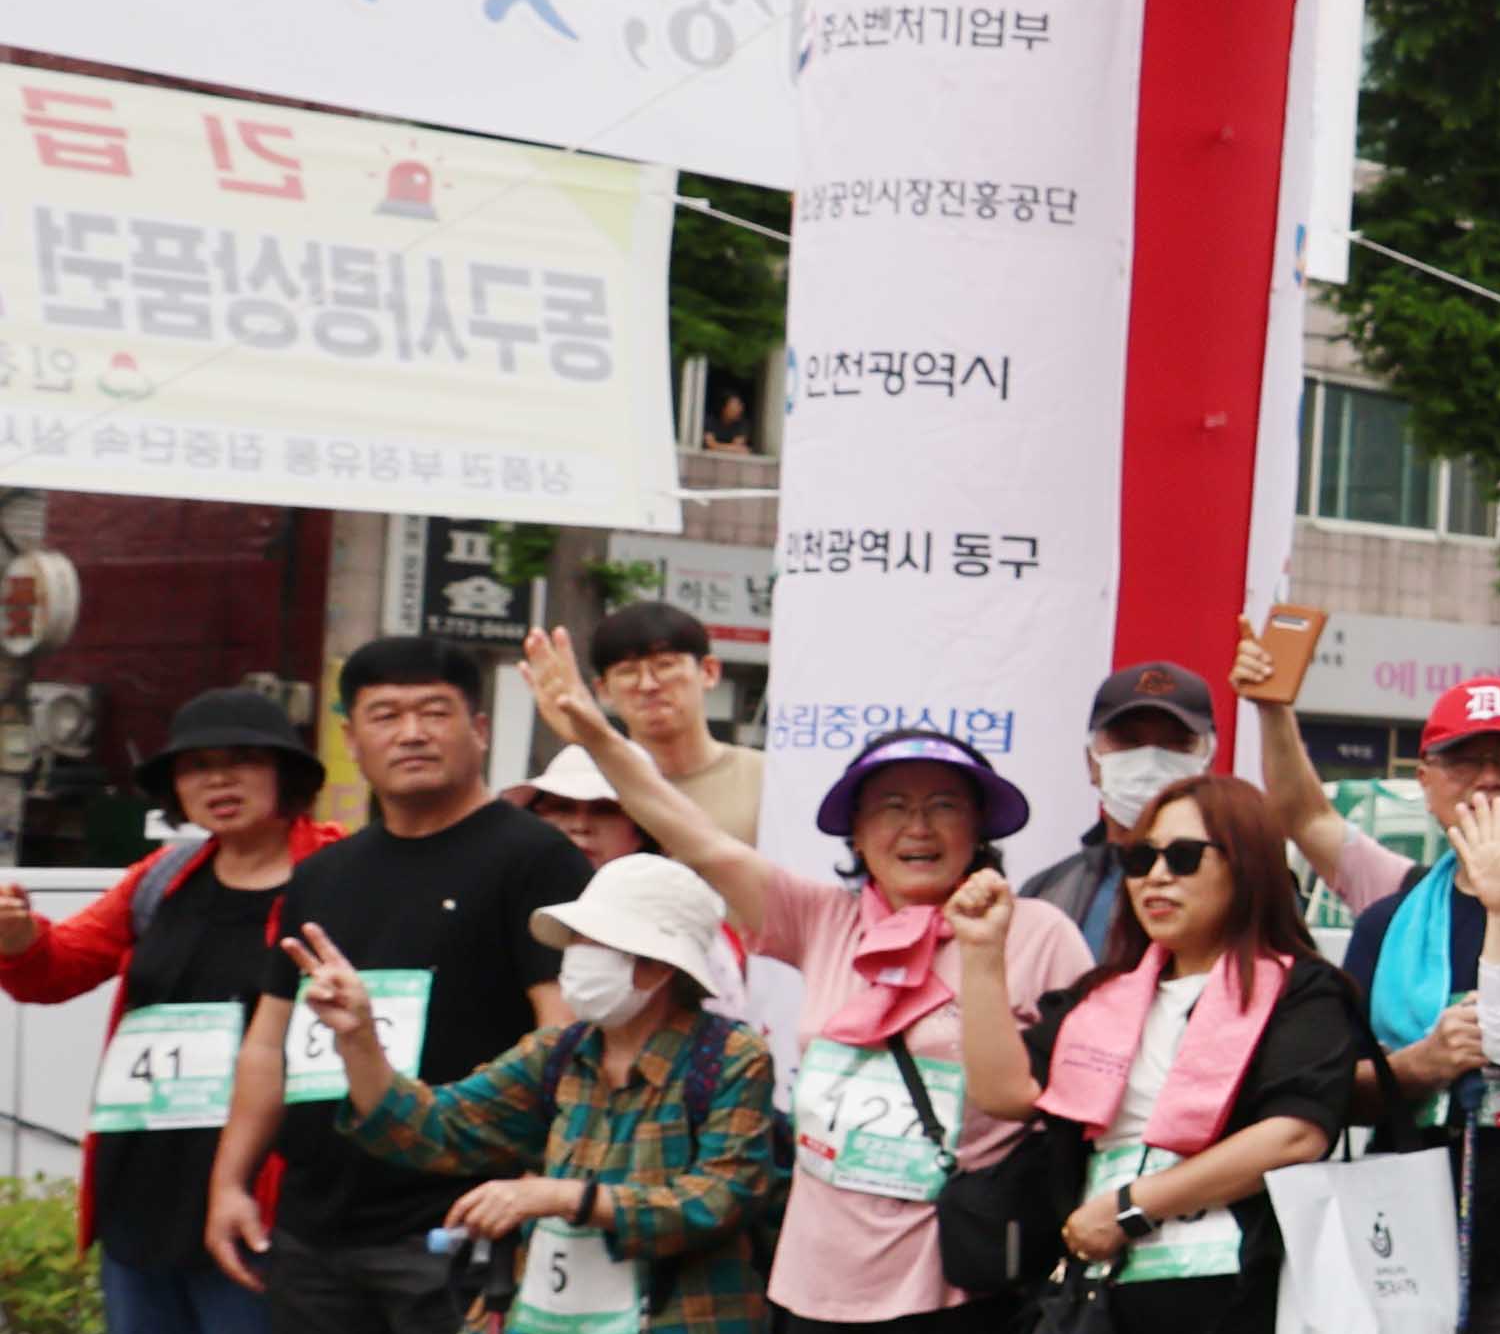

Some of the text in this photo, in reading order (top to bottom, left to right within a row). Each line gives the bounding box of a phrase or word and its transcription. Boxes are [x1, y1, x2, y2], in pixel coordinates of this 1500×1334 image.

[805, 349, 1012, 402] 인천광역시
[952, 532, 1040, 579] 동구
[128, 1044, 181, 1084] 41
[552, 1251, 567, 1293] 5
